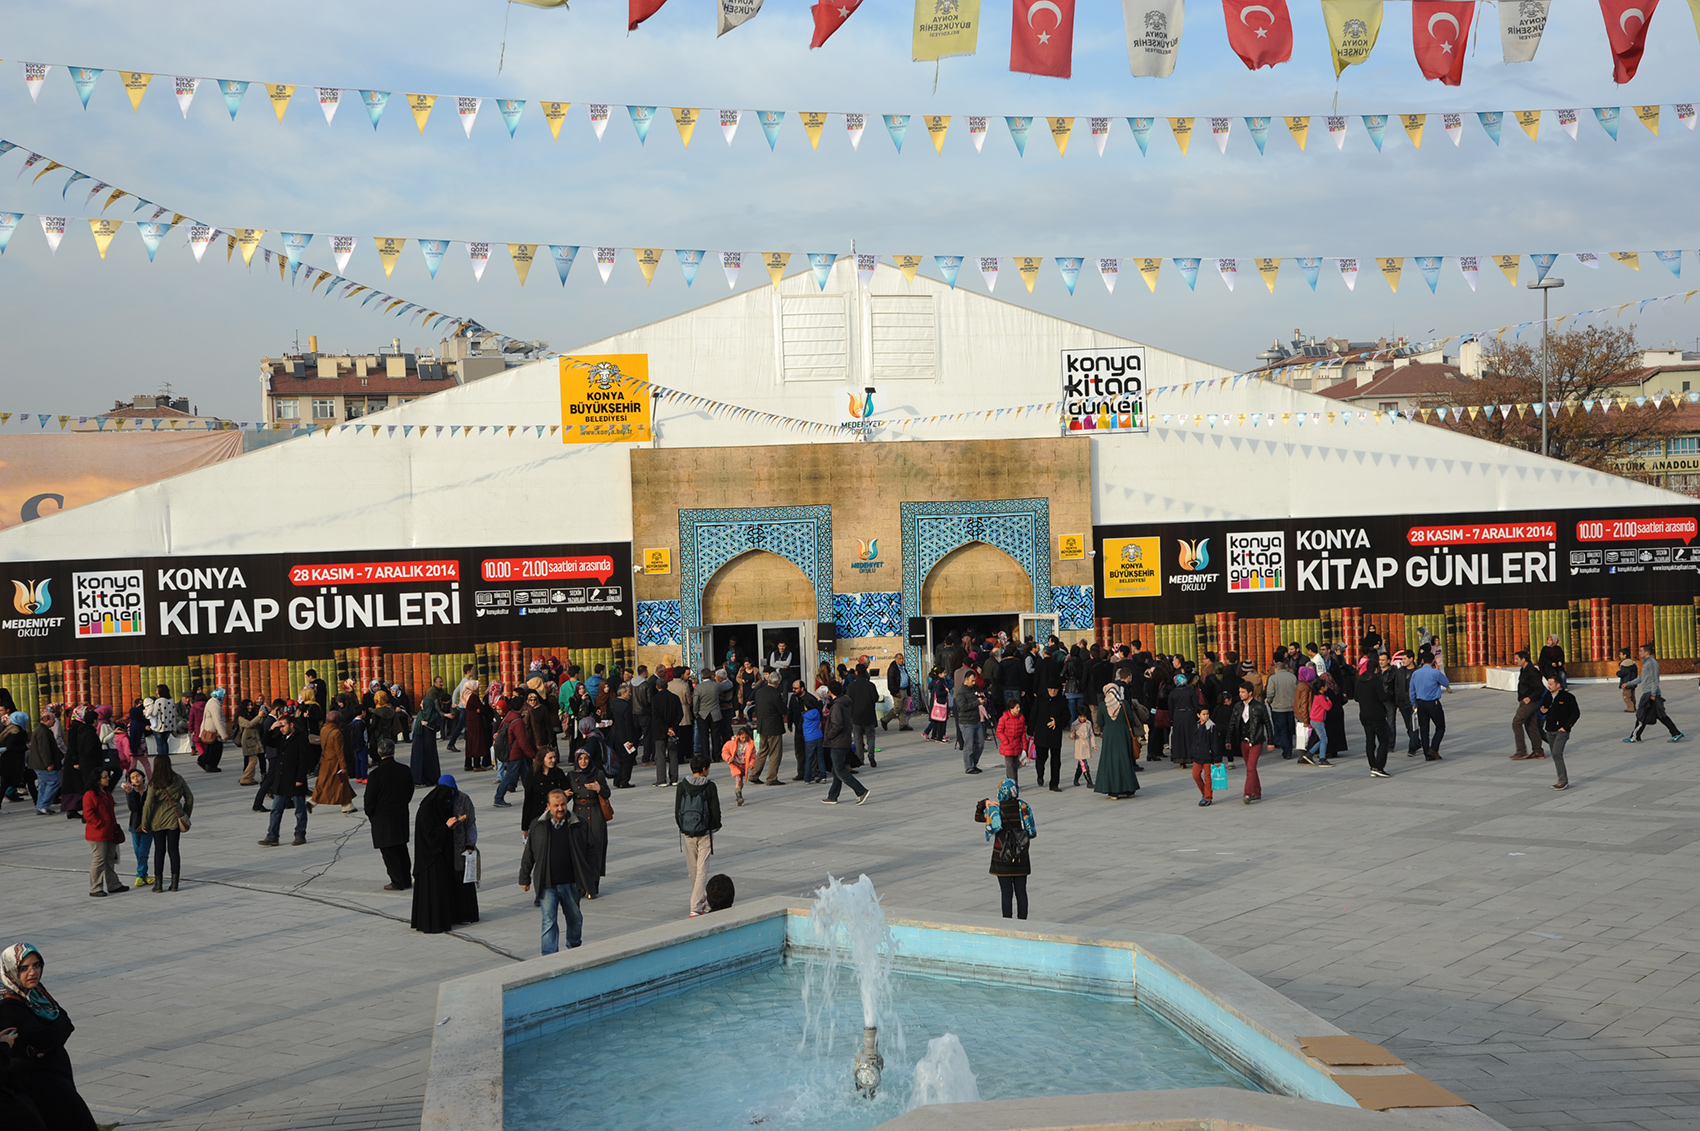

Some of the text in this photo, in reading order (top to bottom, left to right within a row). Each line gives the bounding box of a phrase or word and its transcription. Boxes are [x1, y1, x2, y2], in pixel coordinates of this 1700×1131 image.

[1067, 354, 1141, 376] konya
[1068, 374, 1141, 399] kitap
[587, 392, 624, 400] KONYA
[570, 401, 641, 414] BÜYÜKŞEHİR
[1068, 397, 1142, 420] günleri
[1652, 460, 1699, 470] ANADOLU
[1411, 530, 1424, 542] 28
[1426, 529, 1464, 541] KASIM
[1473, 528, 1480, 540] 7
[1482, 527, 1524, 540] ARALIK
[1526, 526, 1553, 538] 2014
[1579, 522, 1603, 538] 10.00
[1613, 522, 1637, 538] 21.00
[1637, 522, 1664, 533] saatleri
[1665, 521, 1695, 532] arasında
[1230, 536, 1281, 551] konya
[1297, 528, 1371, 550] KONYA
[1231, 550, 1281, 568] kitap
[1297, 543, 1556, 592] KİTAP GÜNLERİ
[294, 569, 309, 581] 28
[312, 568, 354, 581] KASIM
[365, 567, 372, 579] 7
[375, 565, 423, 578] ARALIK
[426, 564, 456, 577] 2014
[484, 561, 511, 578] 10.00
[522, 560, 548, 577] 21.00
[548, 560, 577, 572] saatleri
[578, 559, 611, 572] arasında
[1110, 568, 1155, 578] BÜYÜKŞEHİR
[1230, 566, 1282, 582] günleri
[77, 575, 140, 592] konya
[158, 567, 247, 590] KONYA
[1169, 574, 1220, 584] MEDENİYET
[1181, 583, 1207, 592] OKULU
[78, 591, 140, 610] kitap
[160, 582, 460, 636] KİTAP GÜNLERİ
[2, 617, 65, 629] MEDENİYET
[78, 608, 141, 626] günleri
[18, 628, 49, 637] OKULU
